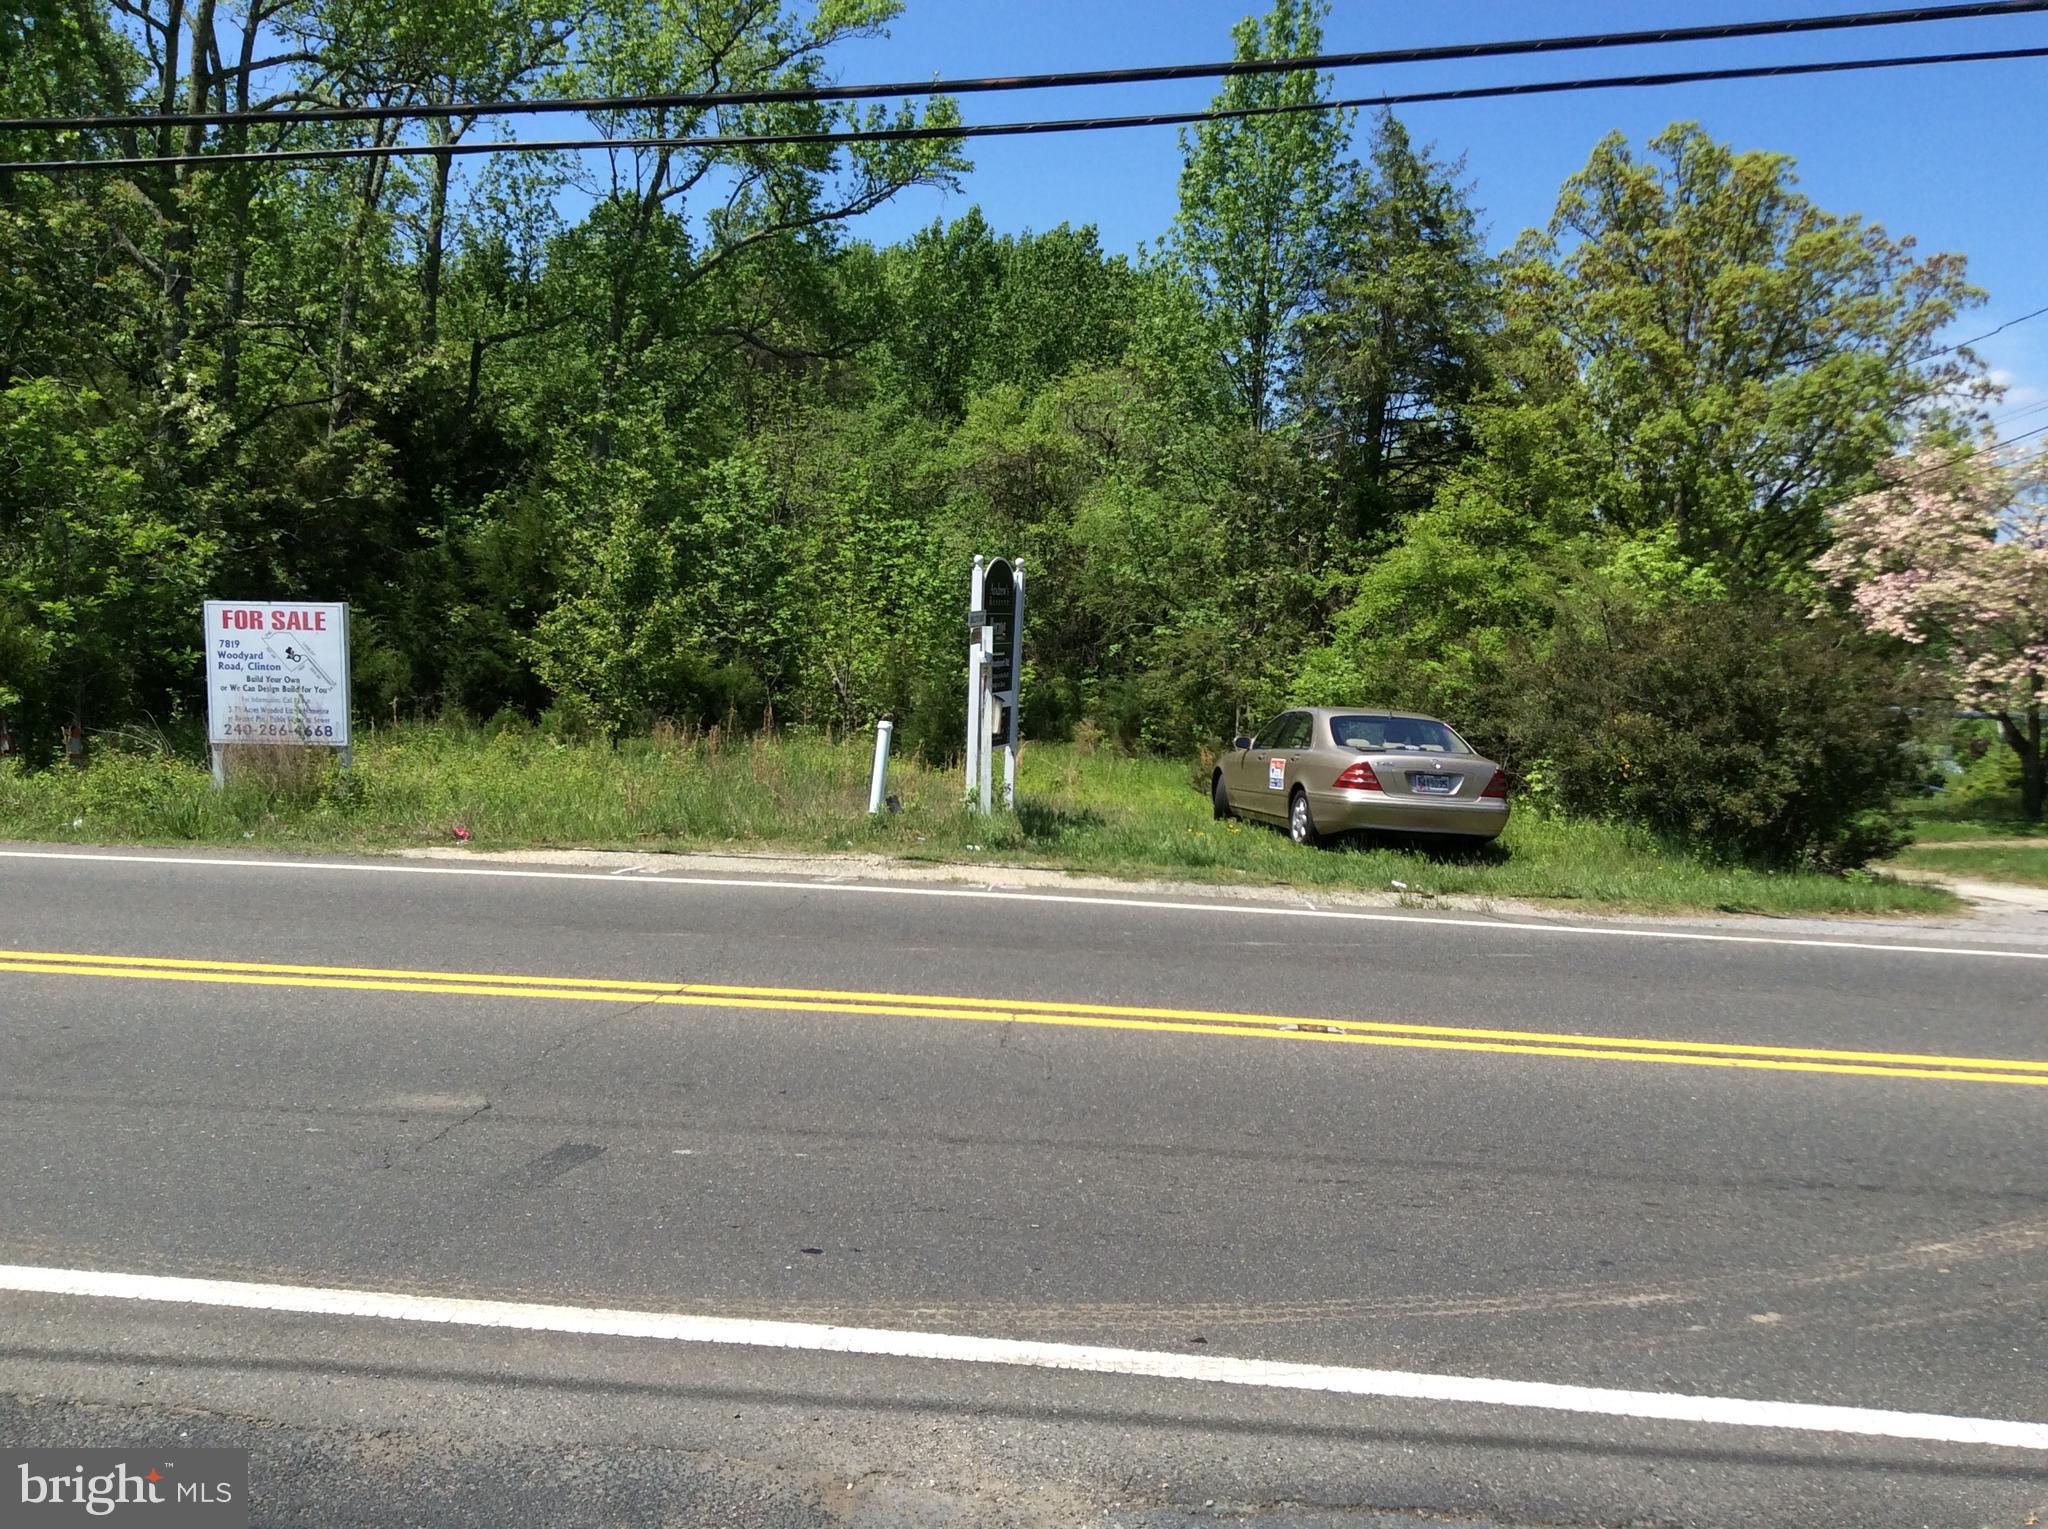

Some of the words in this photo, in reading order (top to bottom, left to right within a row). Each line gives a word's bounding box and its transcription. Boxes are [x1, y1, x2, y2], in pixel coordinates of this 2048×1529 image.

[222, 609, 263, 630] FOR
[271, 610, 326, 631] SALE
[218, 639, 240, 648] 7819
[217, 651, 264, 662] Woodyard
[218, 662, 244, 671] Road,
[248, 662, 281, 671] Clinton
[246, 675, 263, 683] Build
[266, 675, 281, 683] Your
[229, 684, 240, 692] We
[257, 685, 280, 694] Design
[301, 685, 311, 693] for
